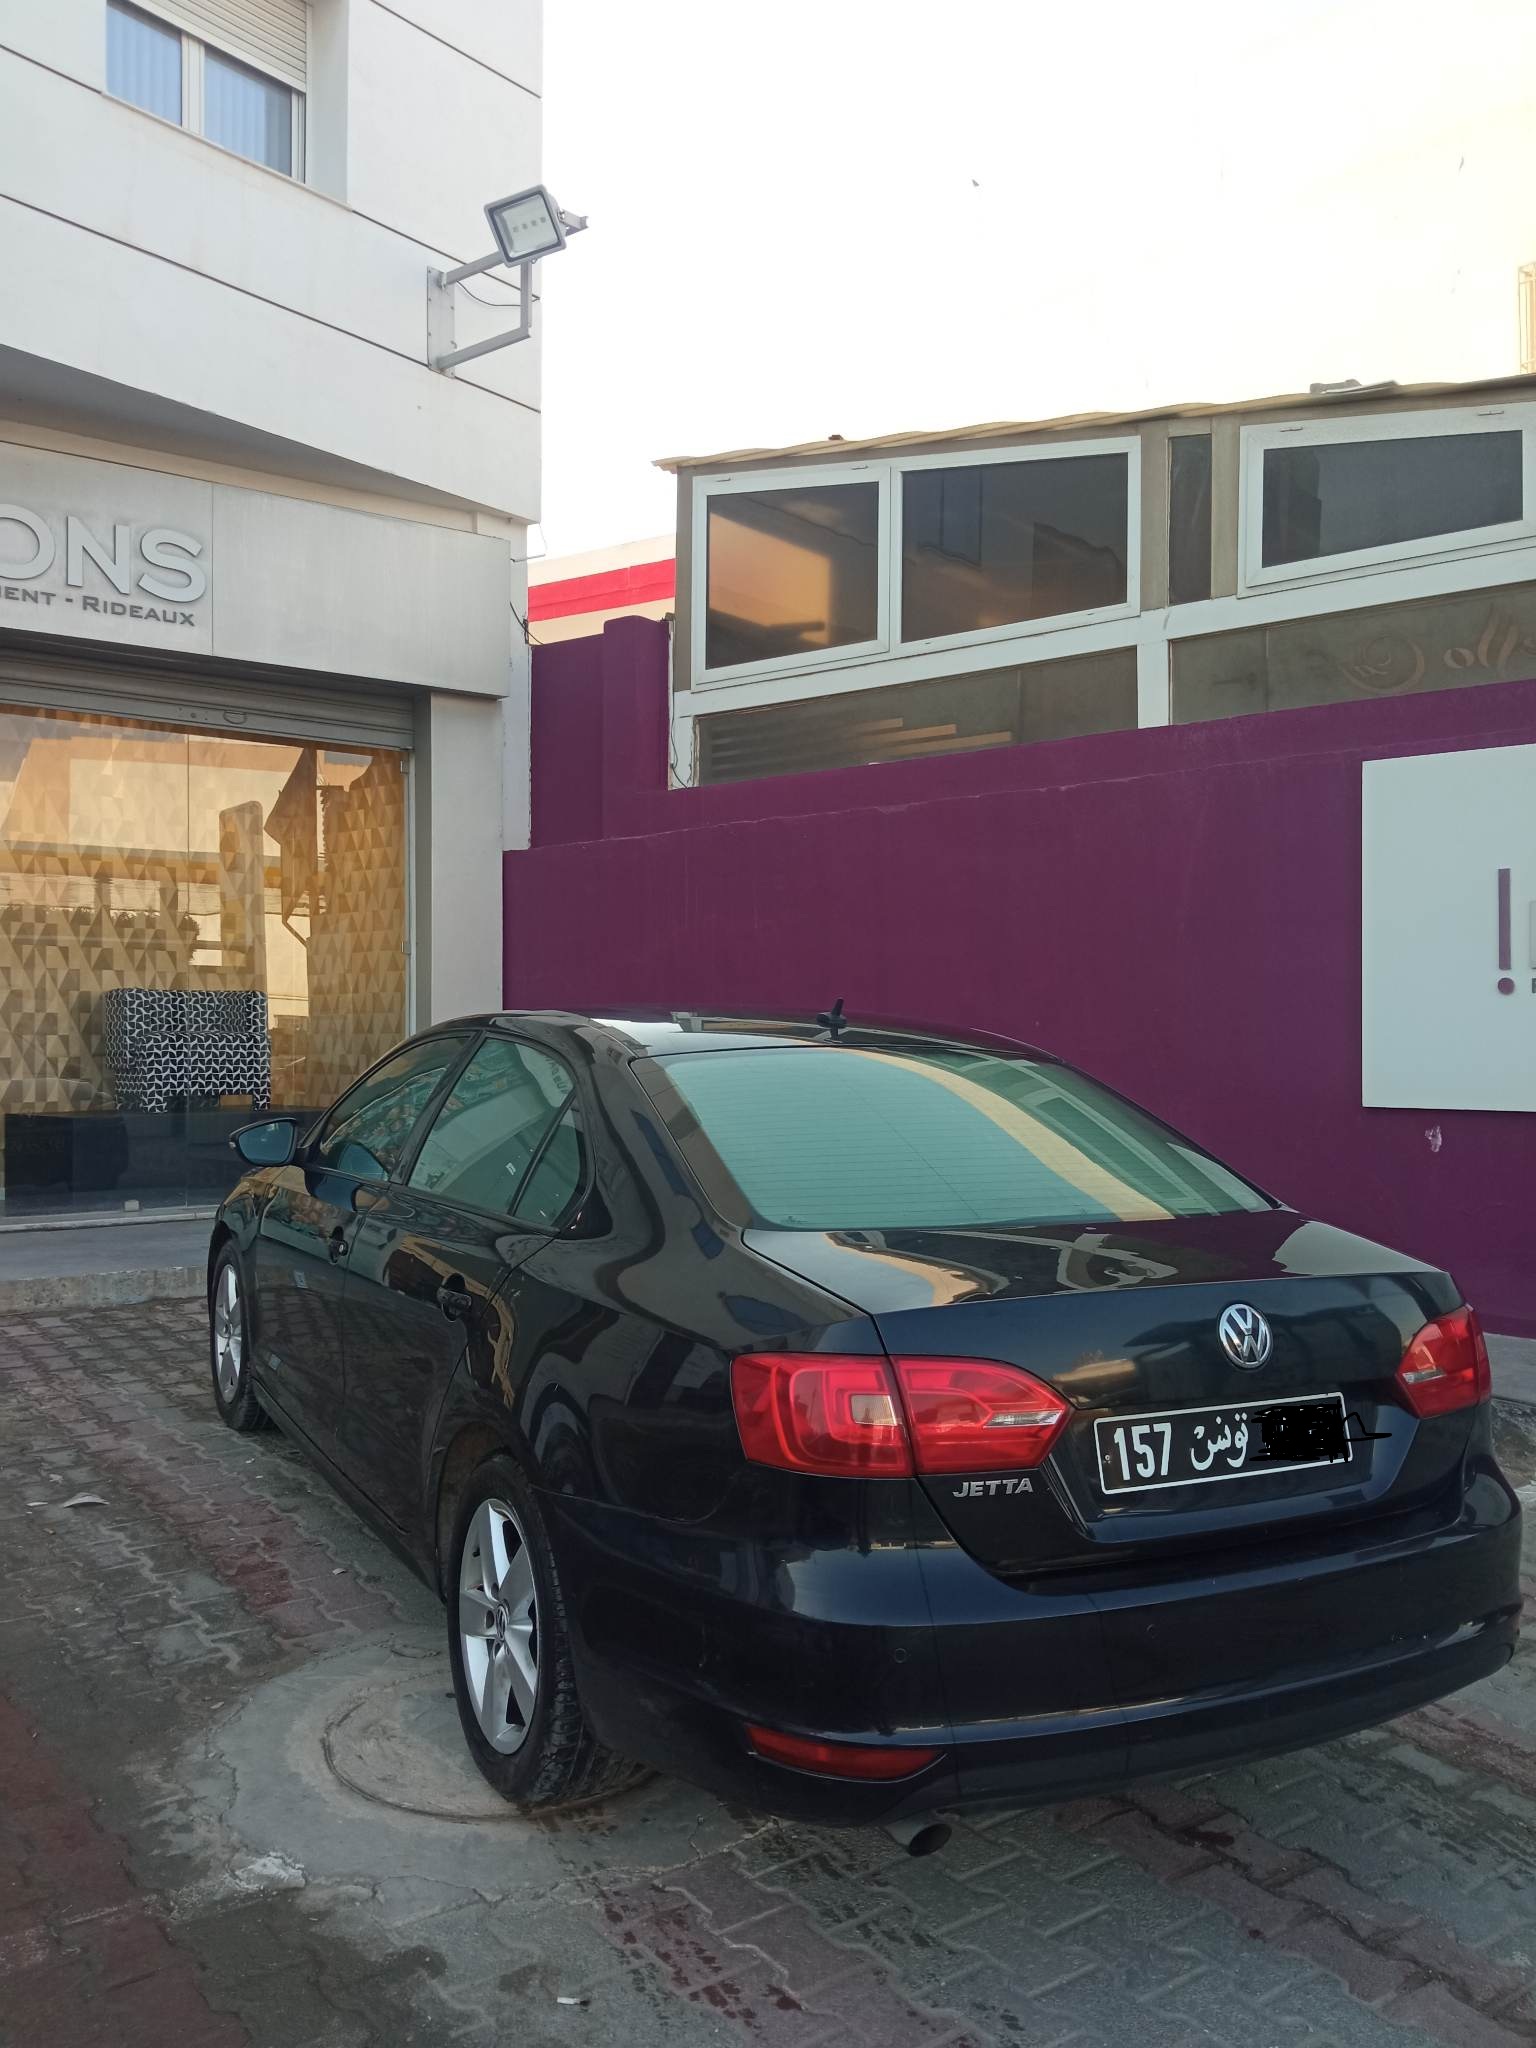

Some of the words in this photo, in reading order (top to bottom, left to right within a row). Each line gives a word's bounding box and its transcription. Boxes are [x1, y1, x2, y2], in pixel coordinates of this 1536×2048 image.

[0, 585, 57, 606] ENT
[82, 595, 195, 627] RIDEAUX
[1113, 1422, 1171, 1481] 157
[1190, 1412, 1249, 1471] تونس
[952, 1477, 1034, 1498] JETTA
